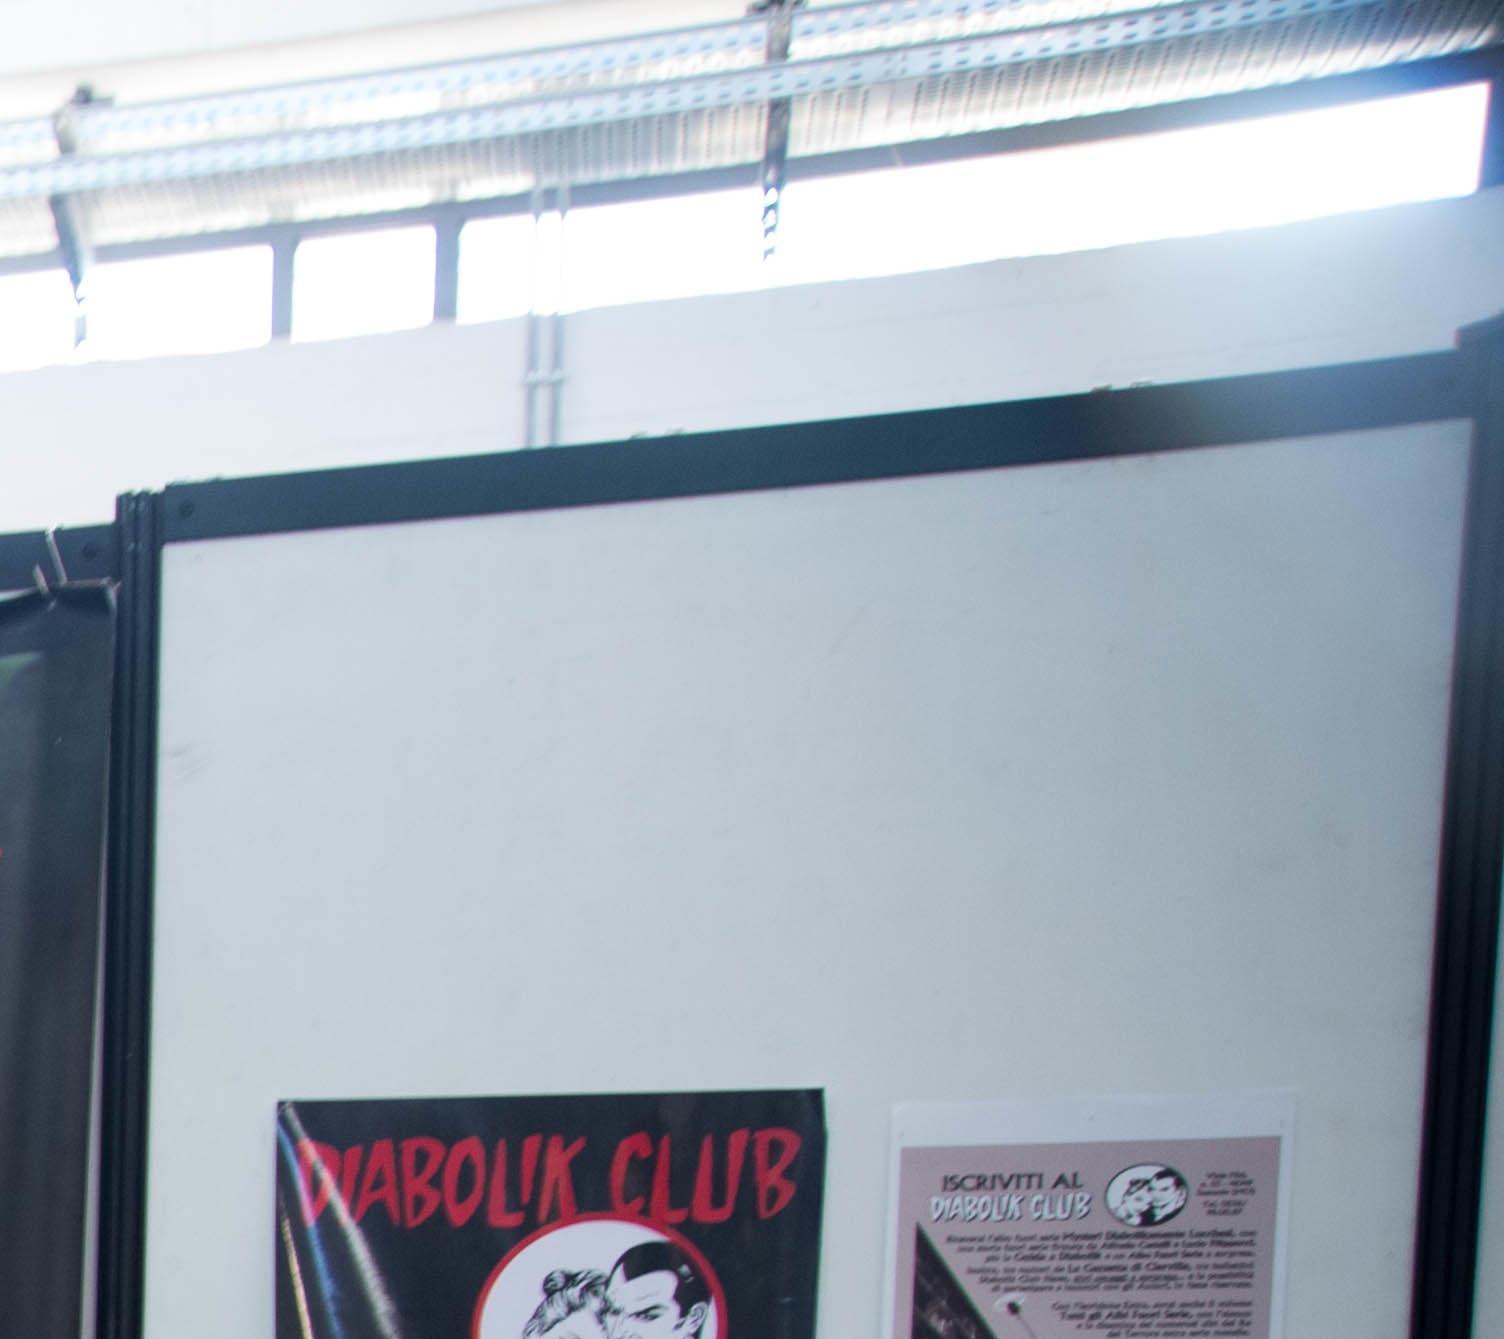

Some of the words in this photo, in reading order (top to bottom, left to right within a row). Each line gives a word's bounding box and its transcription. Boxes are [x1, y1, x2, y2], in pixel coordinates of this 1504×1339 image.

[296, 1134, 588, 1230] DIABOLIK
[611, 1127, 804, 1226] CLUB
[941, 1172, 1043, 1192] ISCRIVITI
[1052, 1171, 1085, 1190] AL
[930, 1195, 1025, 1223] DIABOLIK
[1028, 1193, 1092, 1221] CLUB
